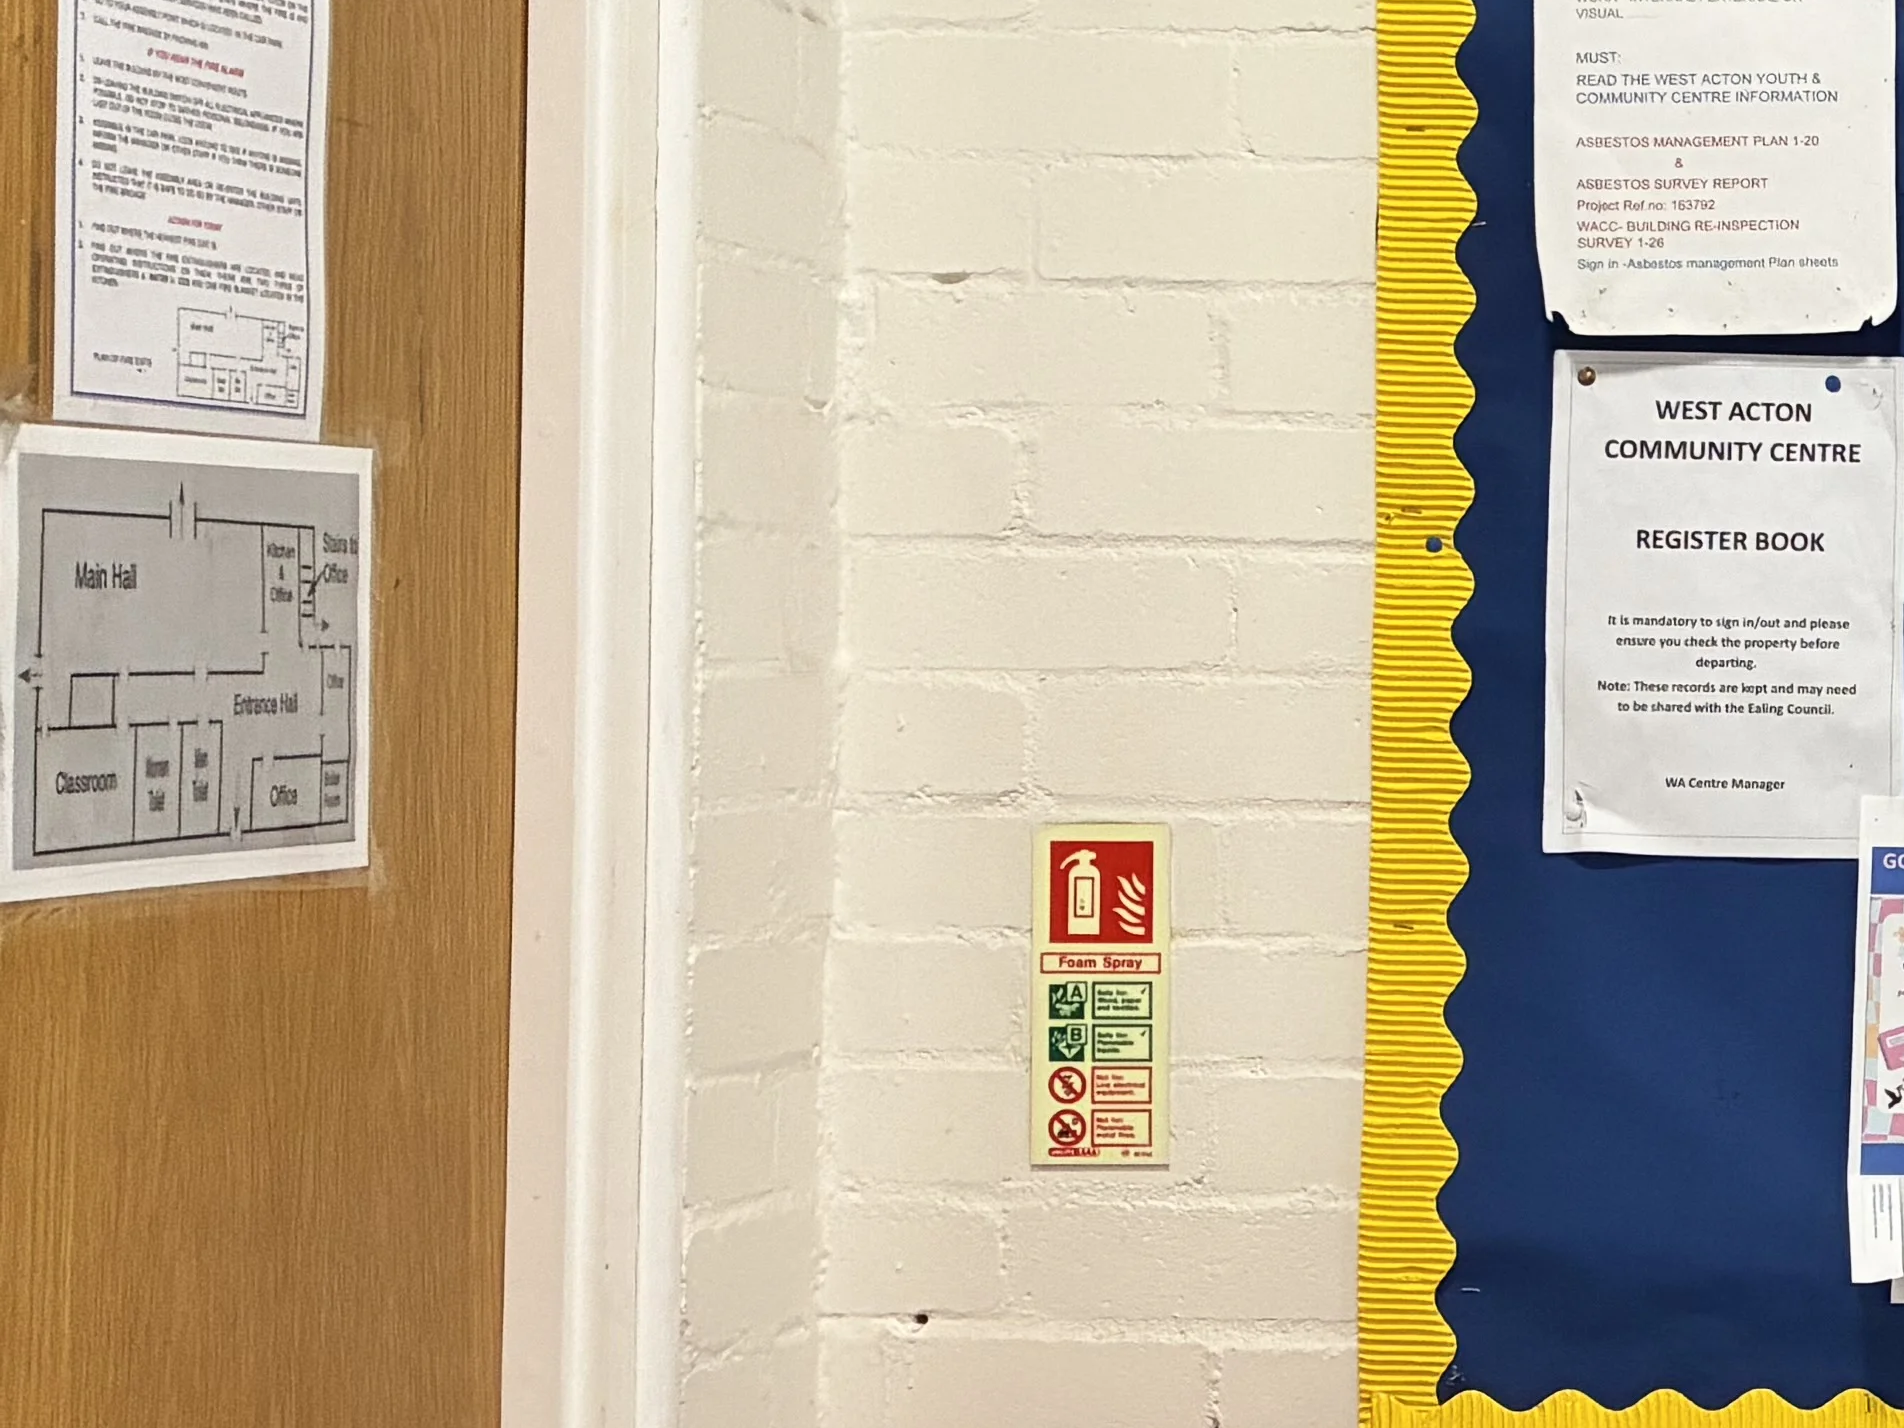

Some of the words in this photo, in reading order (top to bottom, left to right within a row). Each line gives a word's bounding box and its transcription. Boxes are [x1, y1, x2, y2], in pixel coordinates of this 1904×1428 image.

[1575, 51, 1622, 64] MUST:
[1576, 73, 1617, 87] READ
[1620, 73, 1651, 86] THE
[1653, 73, 1697, 86] WEST
[1701, 72, 1752, 85] ACTON
[1756, 72, 1807, 85] YOUTH
[1811, 72, 1821, 84] &
[1576, 91, 1667, 104] COMMUNITY
[1671, 90, 1731, 104] CENTRE
[1735, 89, 1838, 102] INFORMATION
[1655, 400, 1723, 421] WEST
[1728, 401, 1811, 422] ACTON
[1604, 439, 1763, 462] COMMUNITY
[1769, 442, 1861, 463] CENTRE
[1636, 529, 1747, 550] REGISTER
[1755, 531, 1824, 552] BOOK
[75, 562, 108, 588] Main
[112, 563, 137, 590] Hall
[234, 693, 277, 716] Entrance
[280, 692, 298, 714] Hall
[55, 771, 118, 794] Classroom
[1665, 777, 1686, 788] WA
[1688, 777, 1728, 789] Centre
[1731, 778, 1785, 792] Manager
[270, 785, 298, 807] Office
[1058, 956, 1096, 969] Foam
[1103, 956, 1142, 970] Spray
[1071, 985, 1082, 998] A
[1071, 1028, 1082, 1042] B
